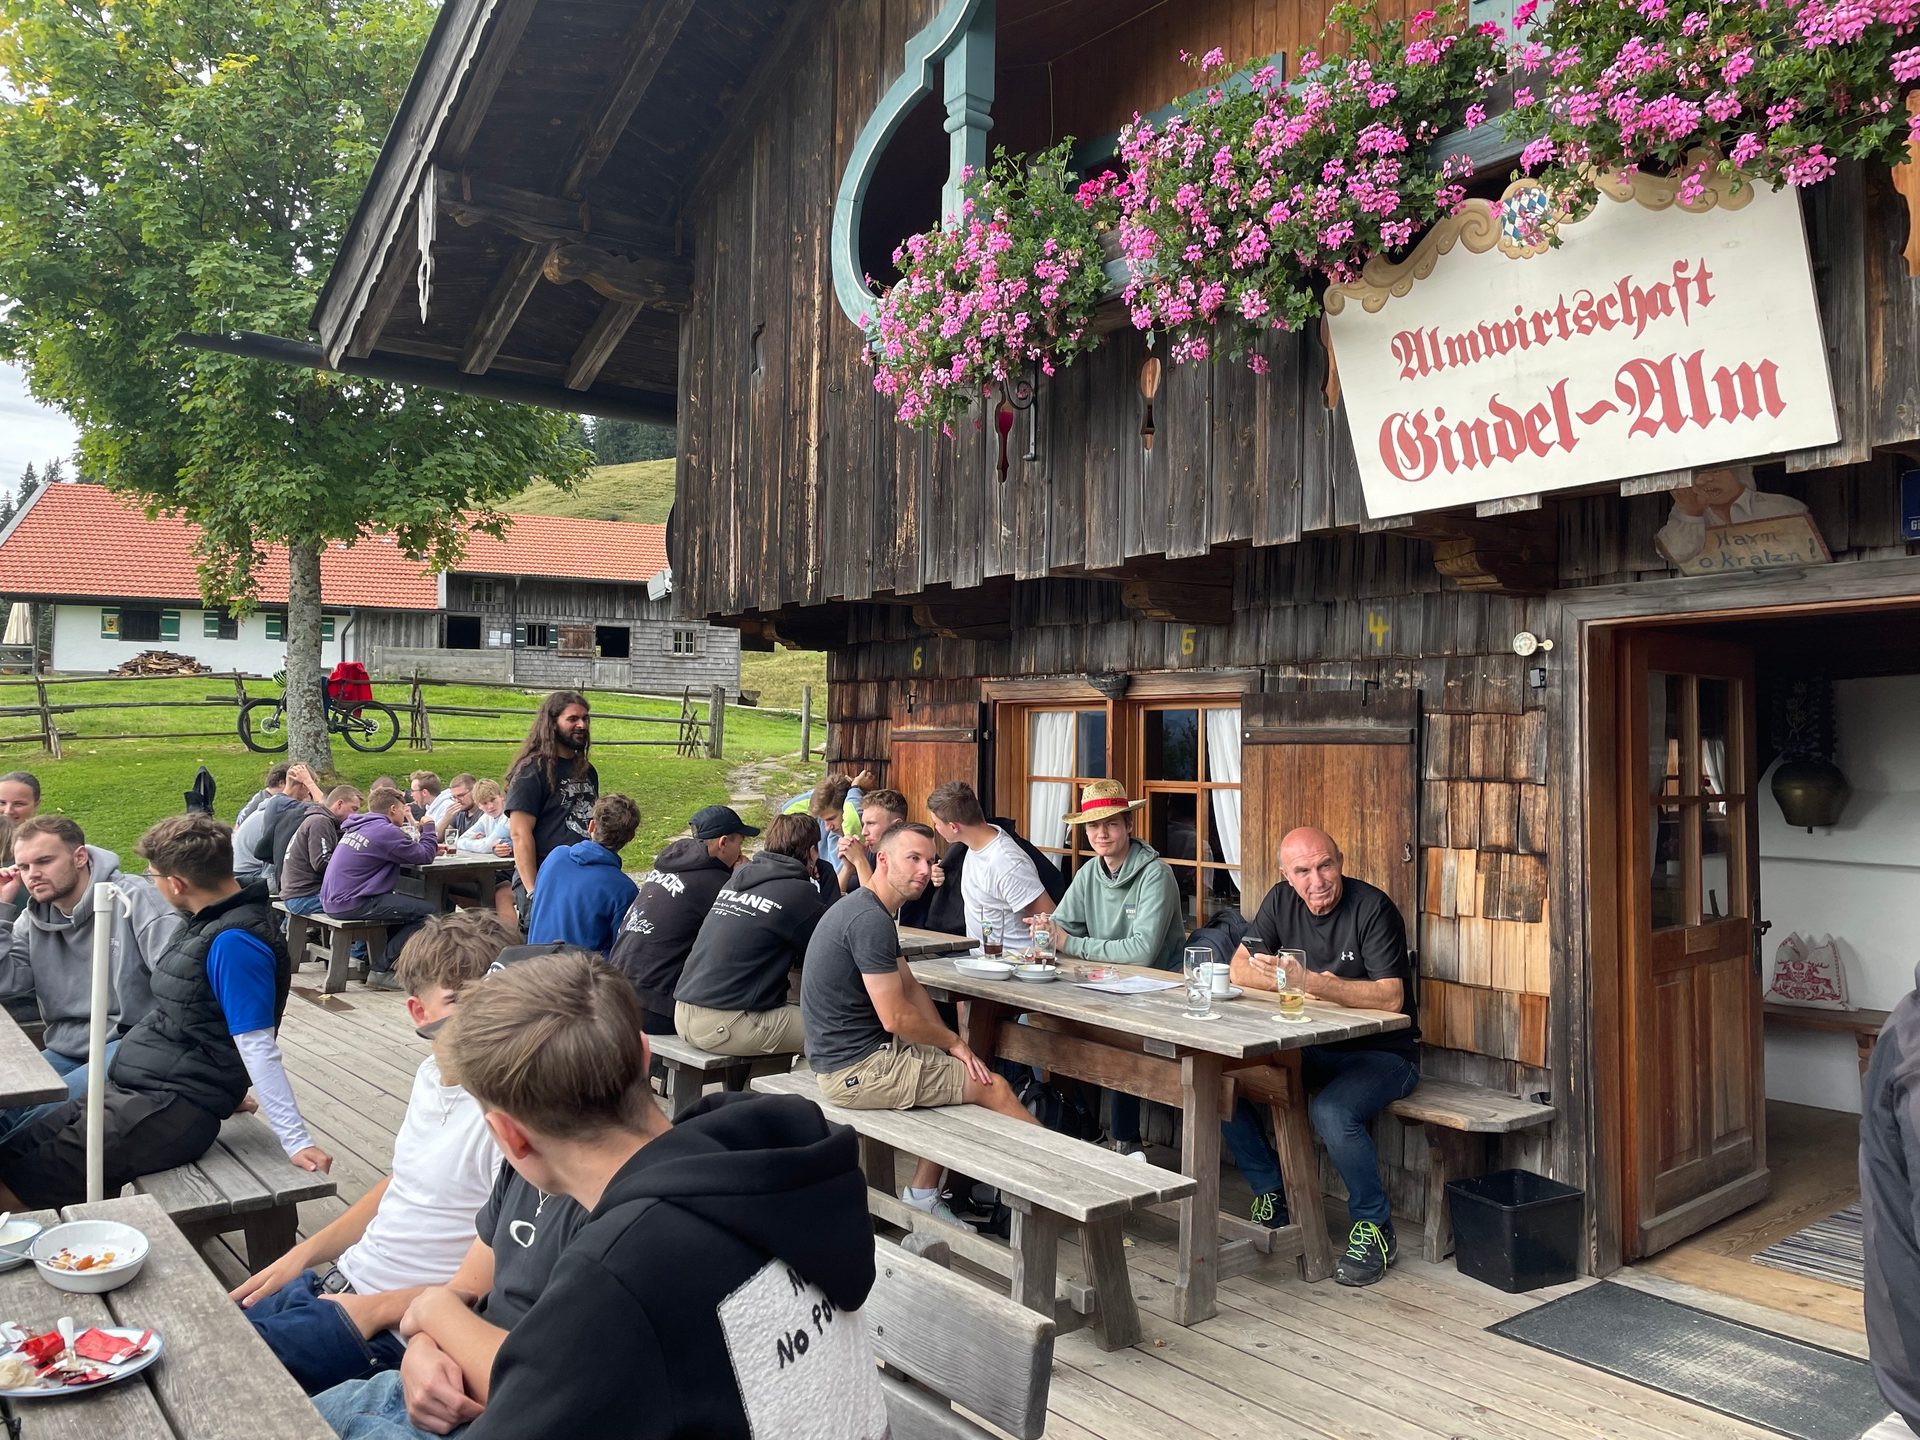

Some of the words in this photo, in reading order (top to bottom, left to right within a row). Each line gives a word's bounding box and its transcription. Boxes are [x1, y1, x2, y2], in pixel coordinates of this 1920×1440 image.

[1391, 257, 1716, 381] Almwirtschaft
[1181, 628, 1196, 656] 5
[1368, 611, 1390, 647] 4
[912, 646, 923, 671] 6
[776, 1328, 809, 1370] NO
[811, 1298, 838, 1336] PO
